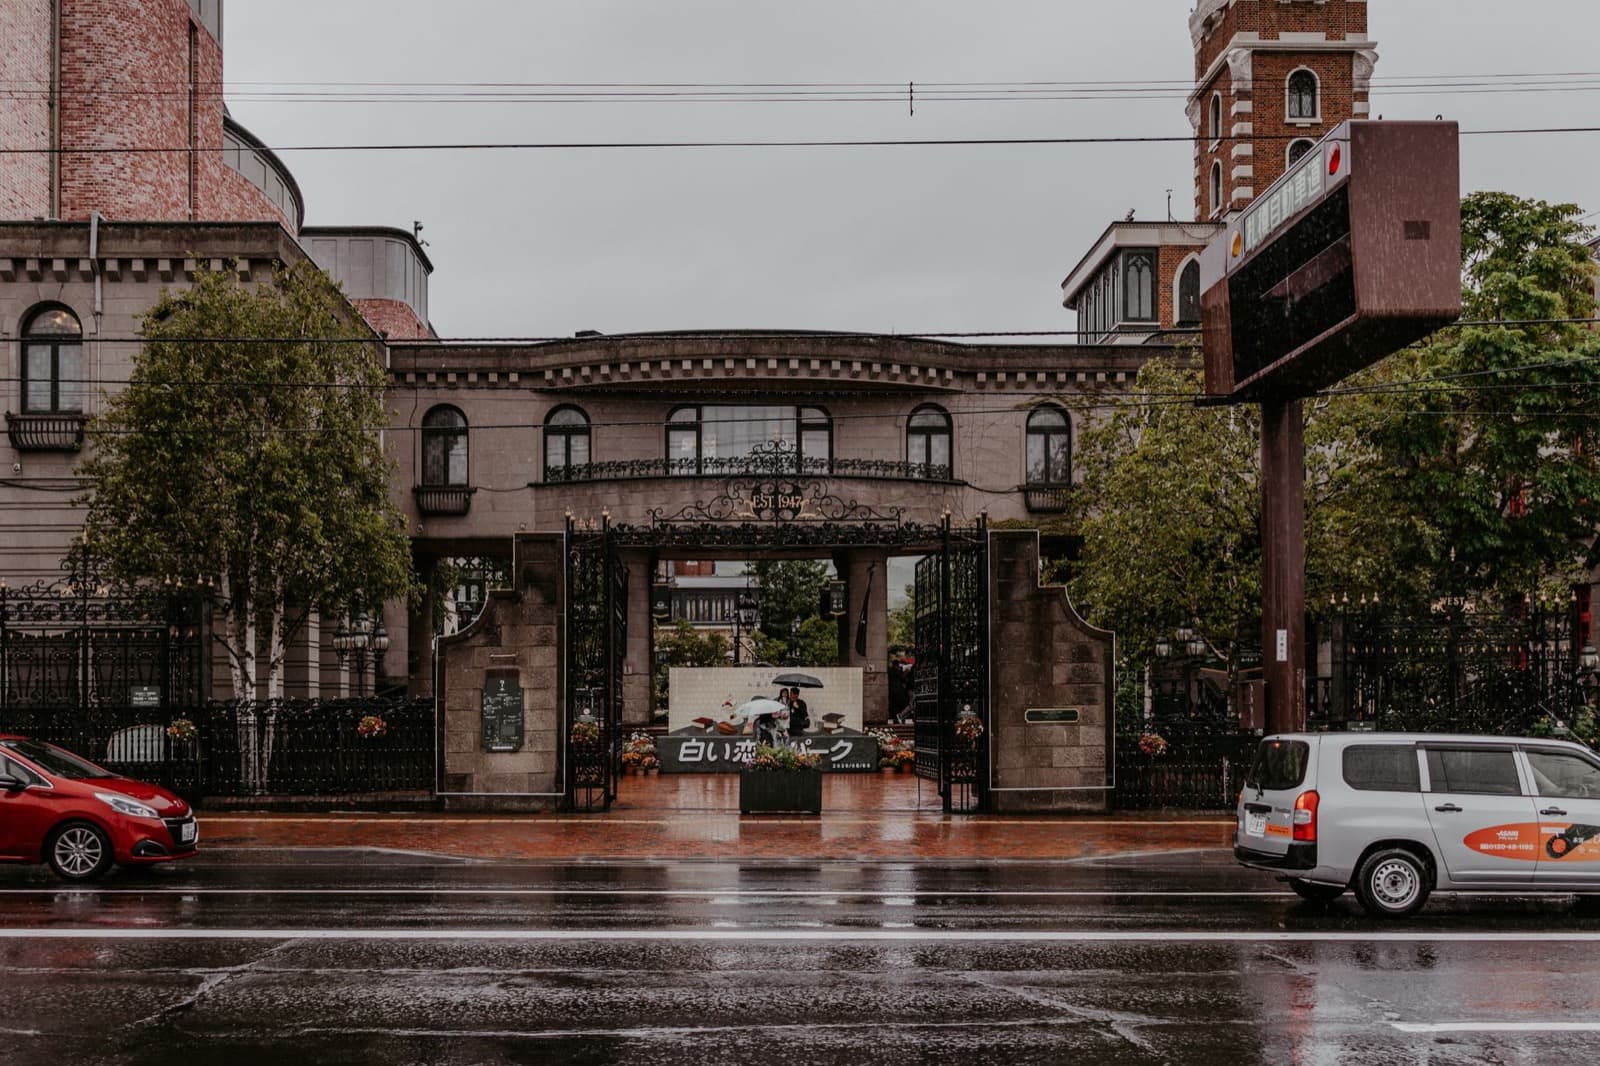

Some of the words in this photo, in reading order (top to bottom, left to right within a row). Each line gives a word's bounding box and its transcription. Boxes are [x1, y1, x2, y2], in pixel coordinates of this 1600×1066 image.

[778, 494, 802, 508] 1947
[72, 581, 96, 590] EAST
[678, 737, 853, 763] 白い恋パーク
